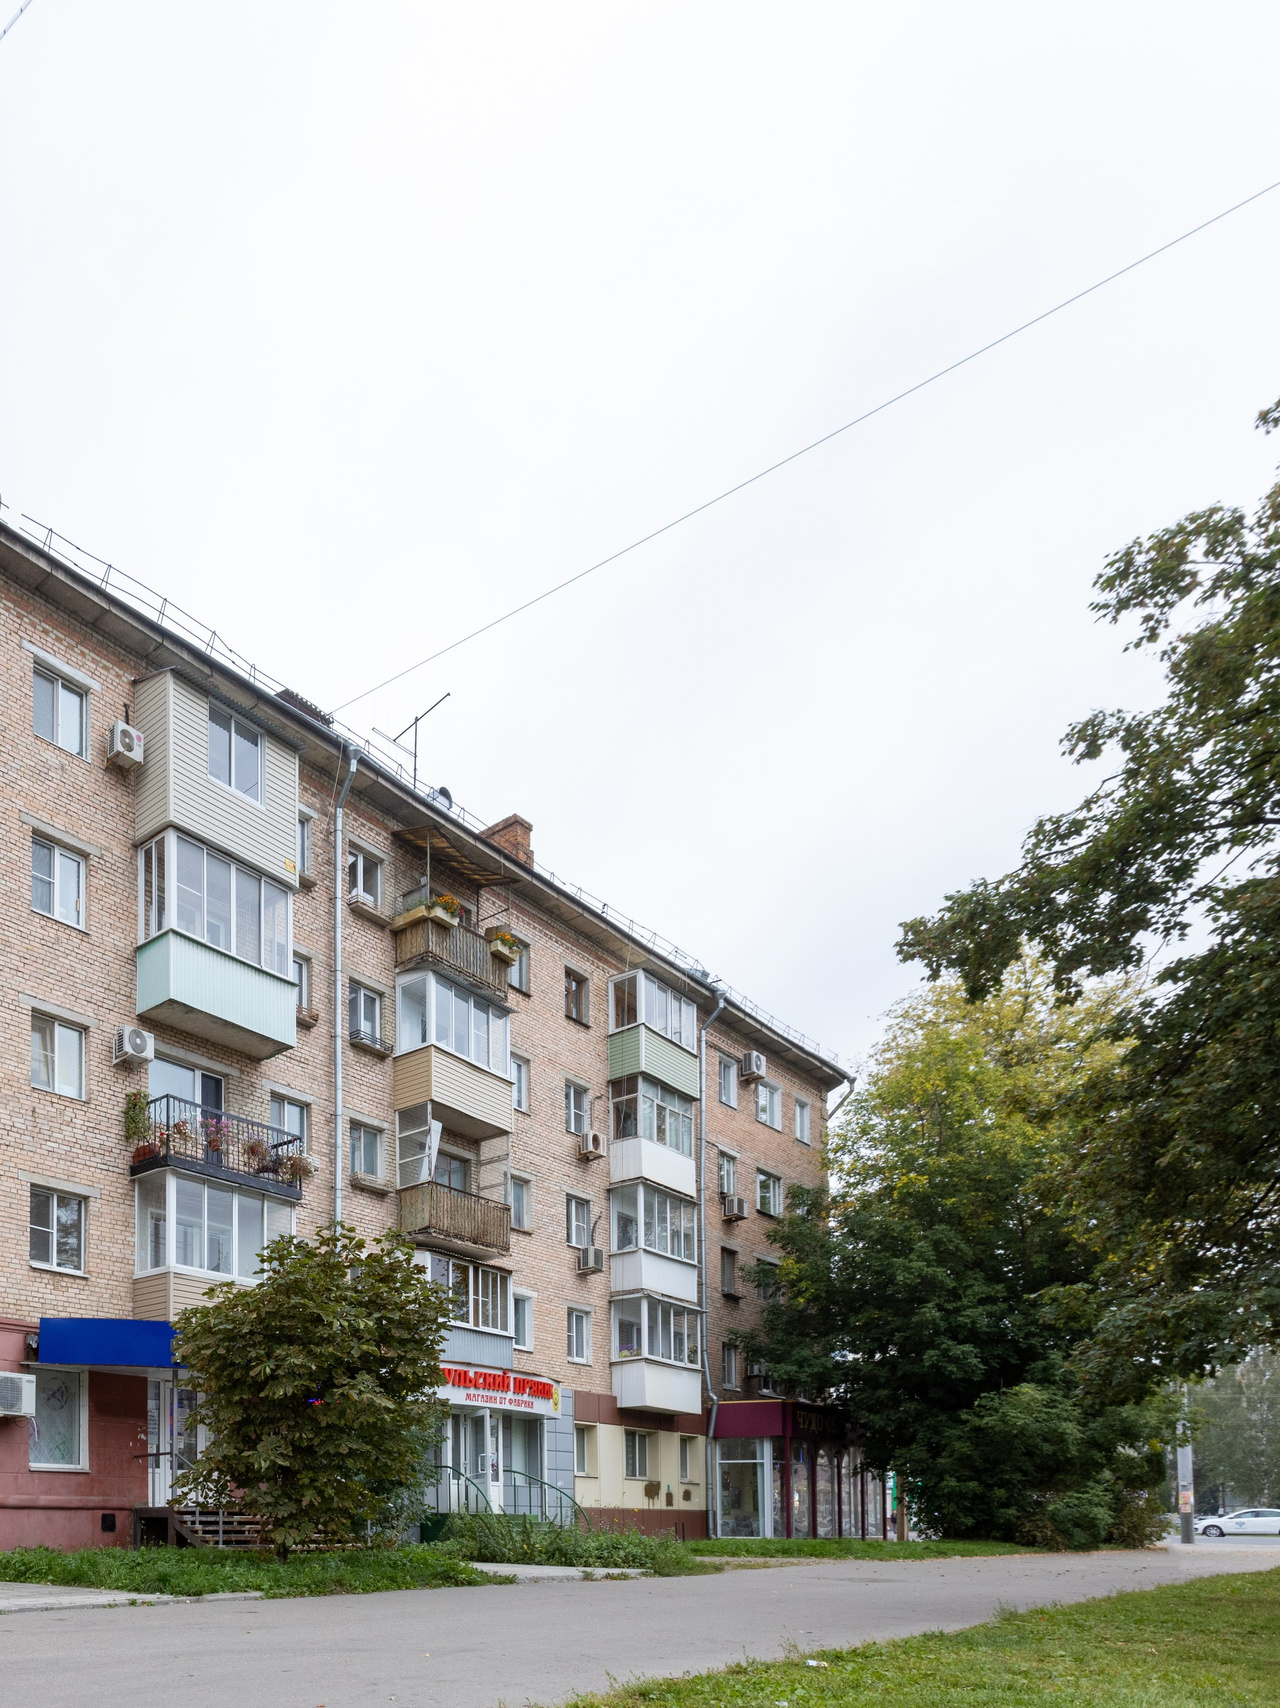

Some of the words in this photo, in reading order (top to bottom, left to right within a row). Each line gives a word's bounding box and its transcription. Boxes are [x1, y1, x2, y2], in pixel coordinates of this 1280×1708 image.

[441, 1368, 511, 1392] УЛЬСКИЙ
[465, 1392, 497, 1404] МАГАЗИН
[499, 1397, 507, 1406] ОТ
[508, 1398, 534, 1409] ФАБРИКИ
[797, 1410, 824, 1434] ЧУДО
